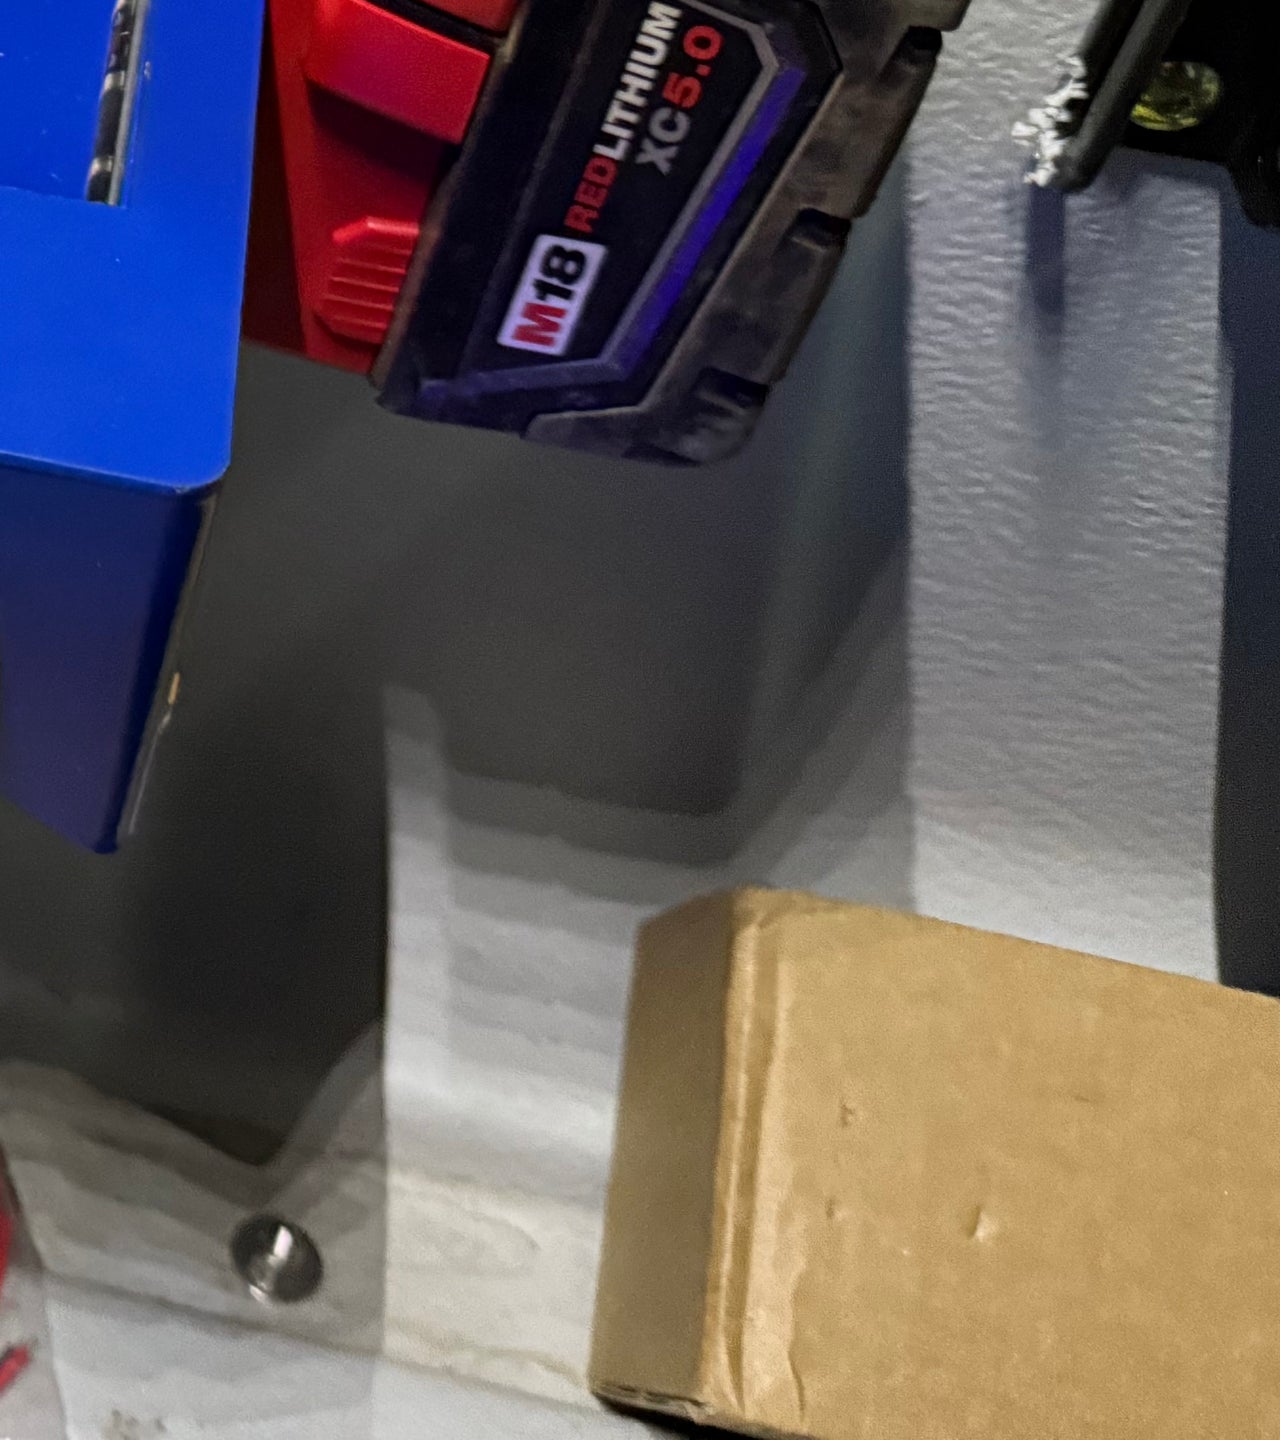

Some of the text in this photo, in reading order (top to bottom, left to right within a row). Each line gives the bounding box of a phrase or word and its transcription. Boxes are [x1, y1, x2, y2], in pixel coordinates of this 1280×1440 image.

[511, 0, 683, 347] M18 REDLITHIUM
[635, 24, 724, 177] XC5.0
